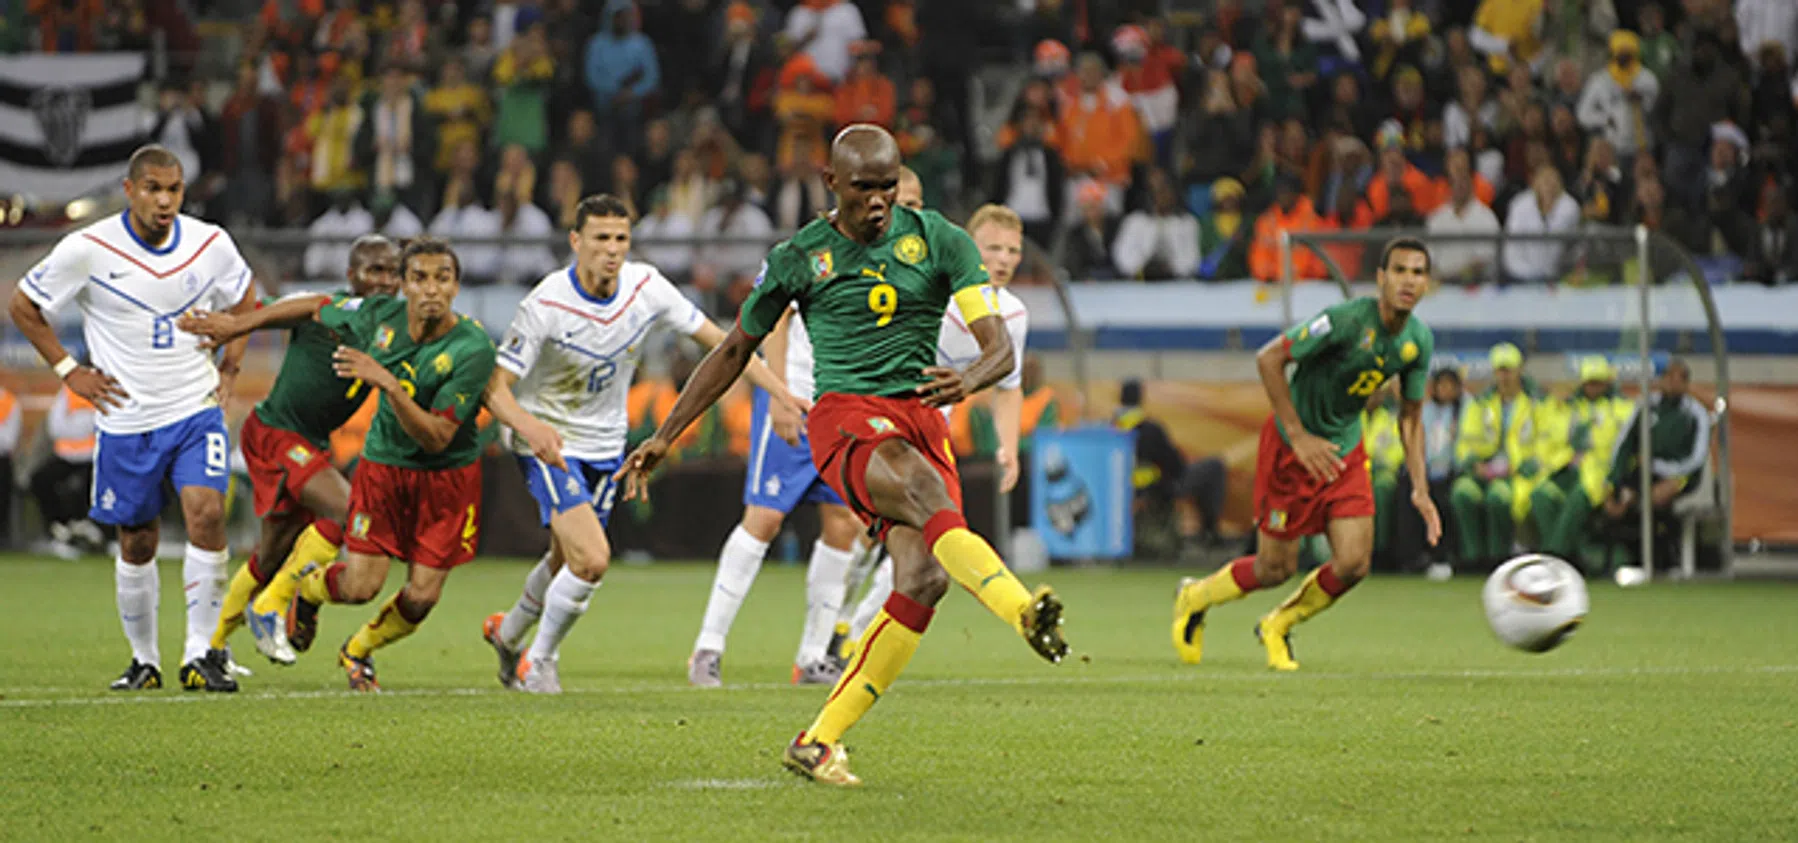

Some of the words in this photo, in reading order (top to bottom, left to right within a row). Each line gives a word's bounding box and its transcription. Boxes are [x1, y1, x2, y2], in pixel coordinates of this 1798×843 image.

[868, 283, 897, 327] 9
[153, 315, 174, 349] 8
[587, 360, 617, 393] 12
[1347, 370, 1384, 396] 13
[207, 432, 226, 469] 8
